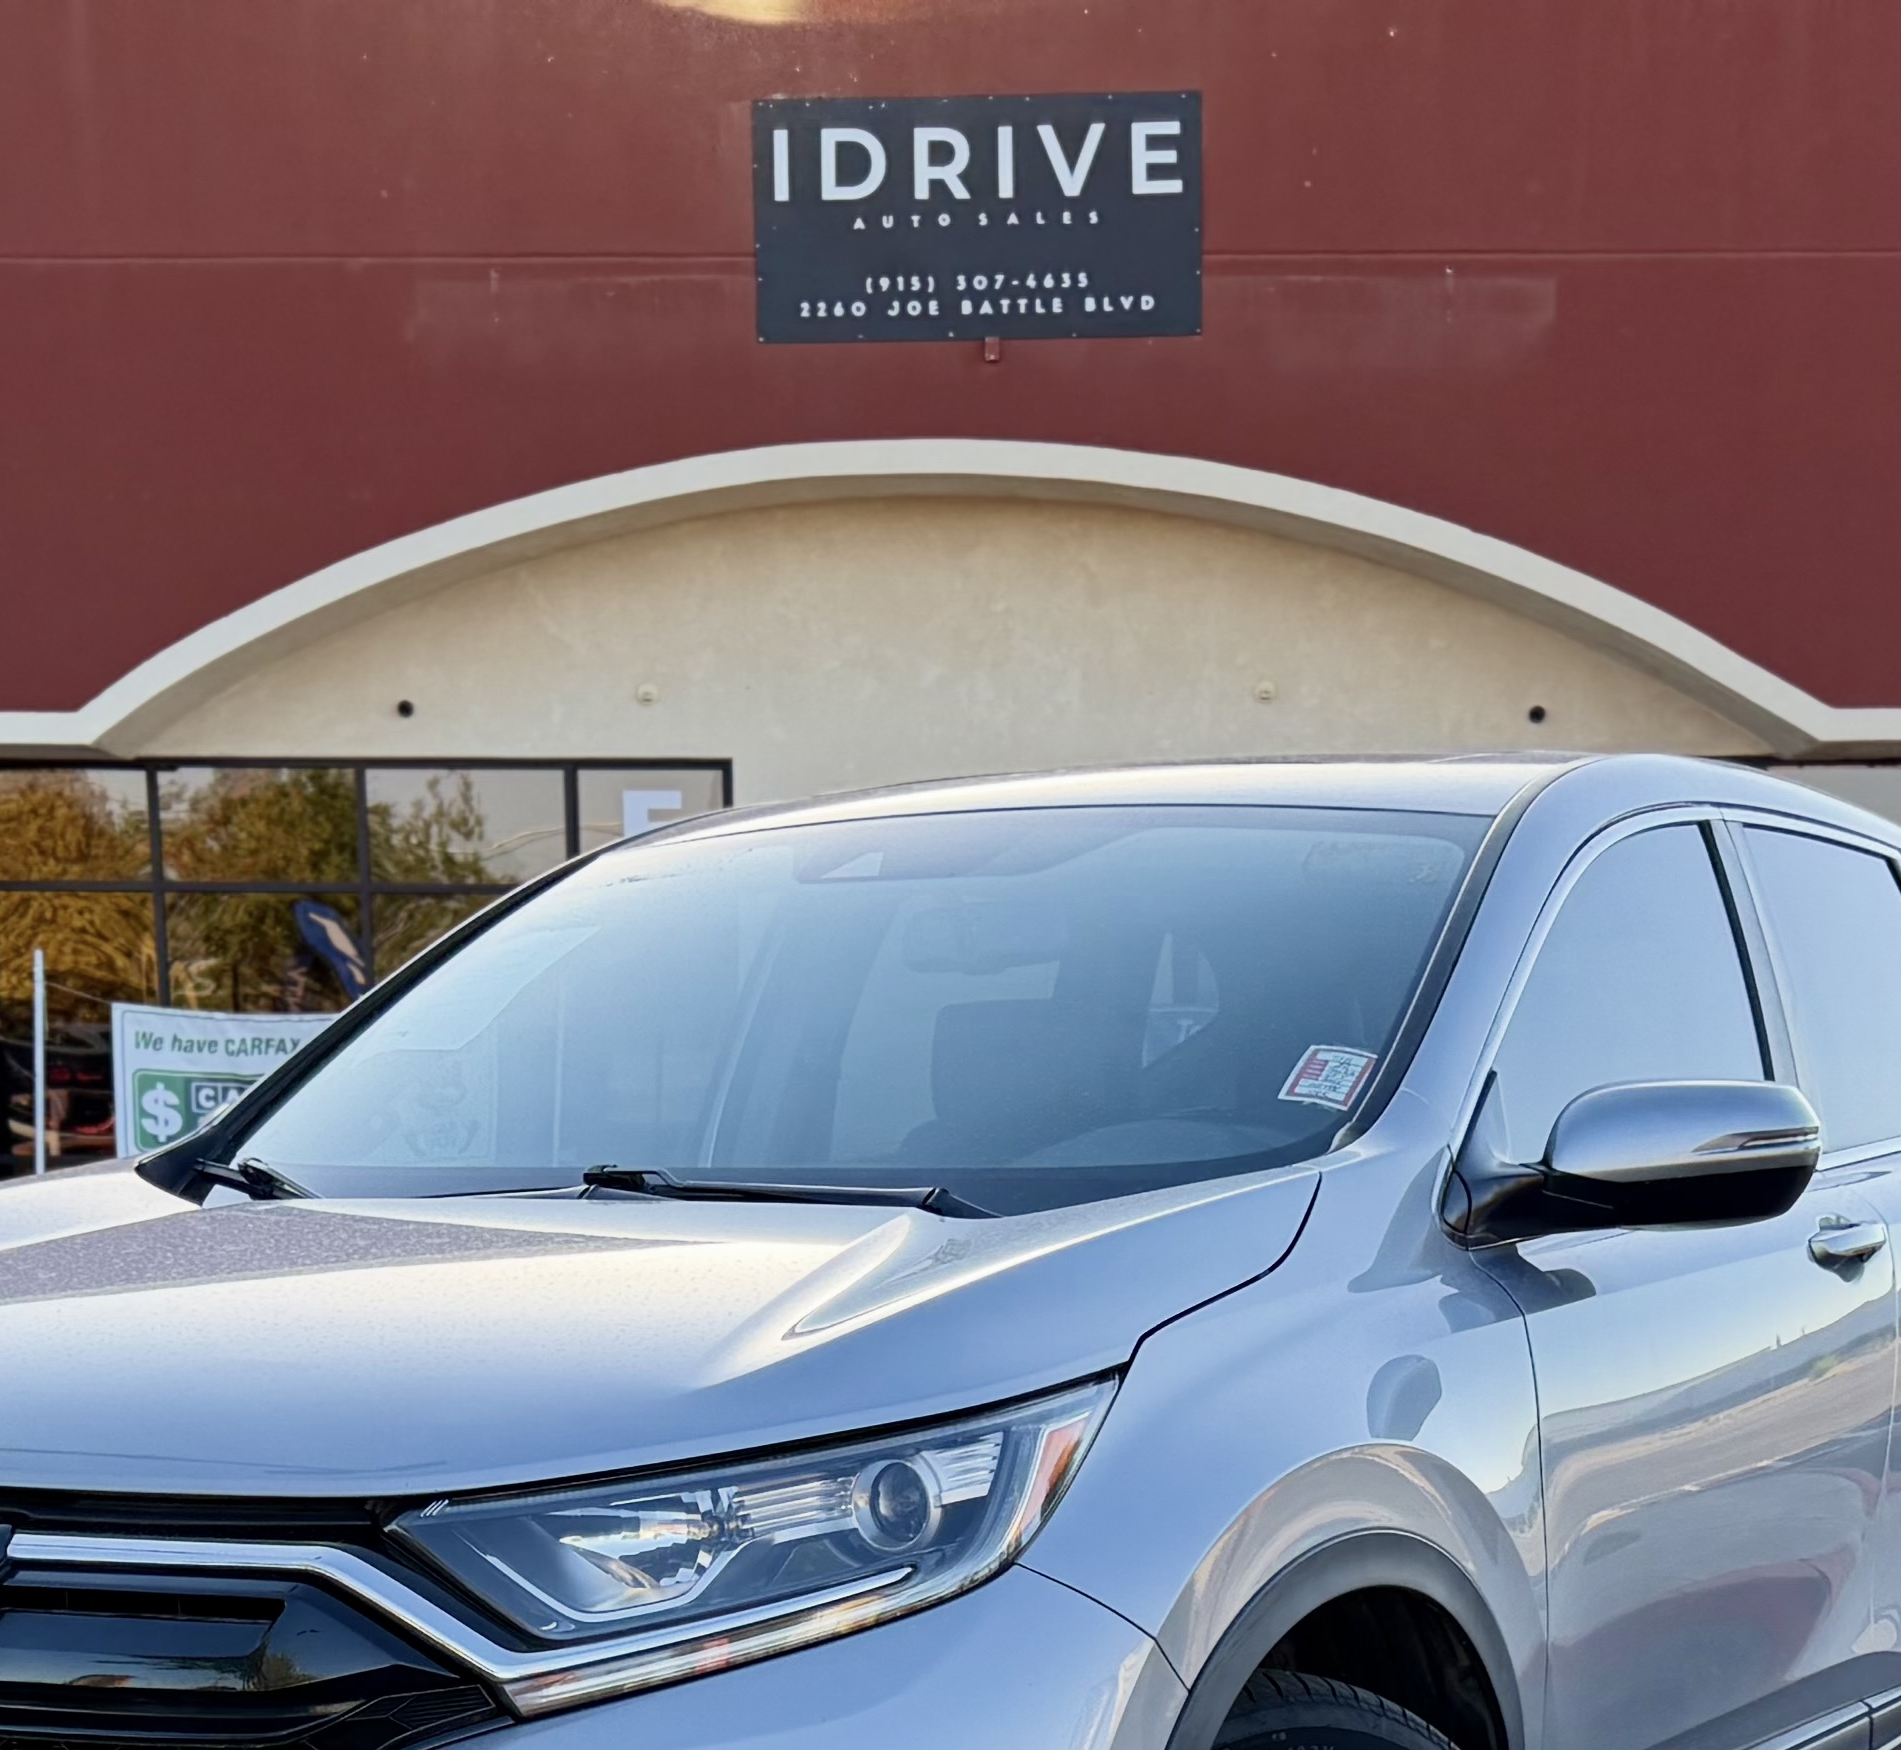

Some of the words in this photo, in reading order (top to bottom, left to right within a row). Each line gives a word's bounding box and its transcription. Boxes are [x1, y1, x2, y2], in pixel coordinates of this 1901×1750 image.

[773, 120, 1184, 202] IDRIVE
[852, 213, 951, 231] AUTO
[978, 210, 1100, 227] SALES
[865, 275, 936, 294] (915)
[956, 272, 1090, 291] 307-4635
[800, 300, 867, 318] 2260
[887, 299, 941, 317] JOE
[961, 297, 1064, 316] BATTLE
[1084, 294, 1156, 312] BLVD
[134, 1030, 164, 1052] We
[171, 1034, 219, 1054] have
[224, 1037, 302, 1057] CARFAX
